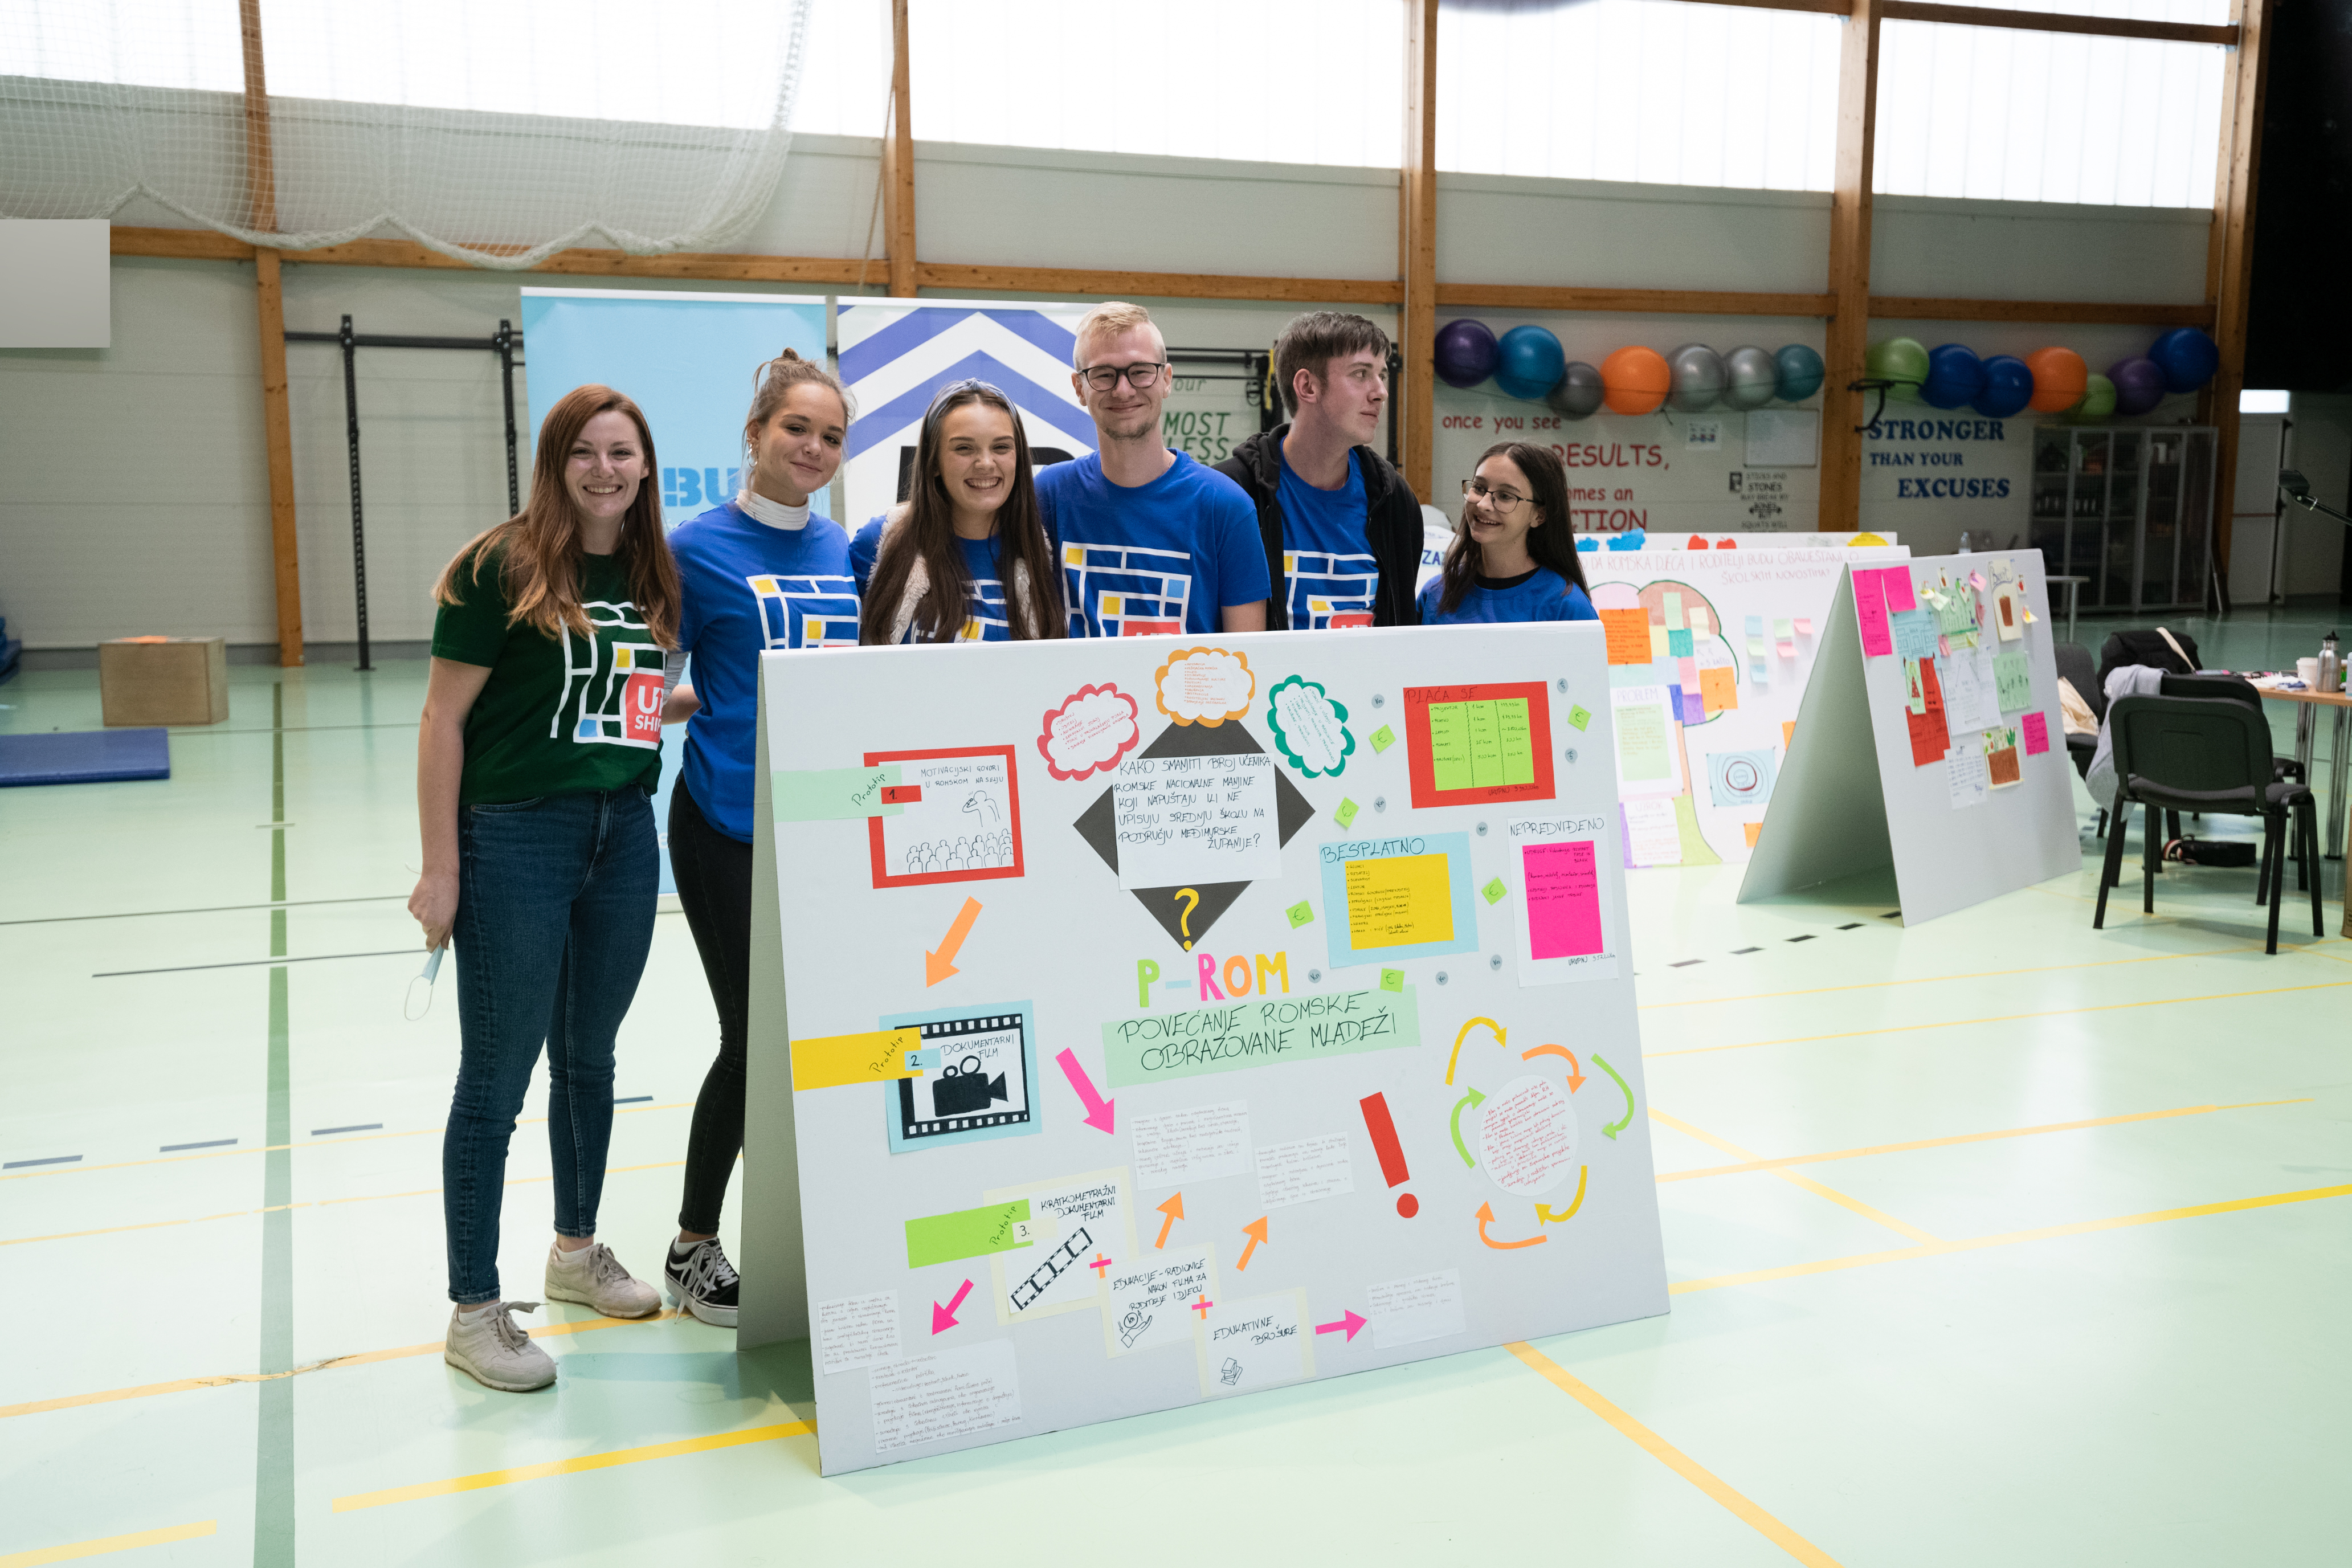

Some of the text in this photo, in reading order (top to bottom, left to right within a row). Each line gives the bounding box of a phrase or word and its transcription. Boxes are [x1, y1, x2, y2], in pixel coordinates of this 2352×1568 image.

[1442, 415, 1562, 434] once you see
[1868, 419, 2004, 440] STRONGER
[1869, 452, 1963, 467] THAN YOUR
[1614, 488, 1634, 501] an
[1897, 477, 2011, 498] EXCUSES
[1572, 509, 1647, 531] TION
[1607, 555, 1651, 571] ROMSKA
[1656, 555, 1685, 571] DJECA
[1699, 552, 1745, 570] RODITELJI
[1747, 553, 1774, 566] BUDU
[1404, 685, 1479, 705] PLAĆA SE
[1617, 687, 1659, 703] PROBLEM
[921, 765, 972, 778] MOTIVACIJSKI
[1120, 754, 1271, 775] KAKO SMANJITI BROJ UČENIKA
[851, 773, 886, 806] Prototip
[925, 780, 930, 789] U
[934, 778, 969, 787] ROMSKOM
[1113, 776, 1255, 793] ROMSKE NACIONALNE MANJINE
[1118, 791, 1242, 812] KOJI NAPUŠTAJU ILI NE
[1635, 800, 1663, 812] UZROK
[1118, 807, 1264, 829] UPISUJU SREDNJU ŠKOLU NA
[1510, 818, 1604, 836] NEPREDVIĐENO
[1118, 826, 1238, 845] PODRUČJU MEĐIMURSKE
[1320, 838, 1426, 863] BESPLATNO
[1137, 951, 1290, 1008] P-ROM
[1118, 991, 1369, 1043] POVEĆANJE ROMSKE
[940, 1034, 1015, 1056] DOKUMENTARNI
[1141, 1005, 1396, 1070] OBRAZOVANE MLADEŽI
[869, 1036, 923, 1073] Prototip 2.
[977, 1048, 999, 1060] FILM
[1041, 1184, 1116, 1211] KRATKOMETRAŽNI
[1054, 1197, 1116, 1219] DOKUMENTARNI
[989, 1206, 1030, 1246] Prototip 3.
[1080, 1209, 1104, 1222] FILM
[1148, 1272, 1207, 1295] NAKON FILMA ZA
[1129, 1294, 1167, 1311] RODITELJE
[1177, 1284, 1203, 1301] DJECU
[1213, 1315, 1274, 1340] EDUKATIVNE
[1251, 1324, 1298, 1345] BROŠURE
